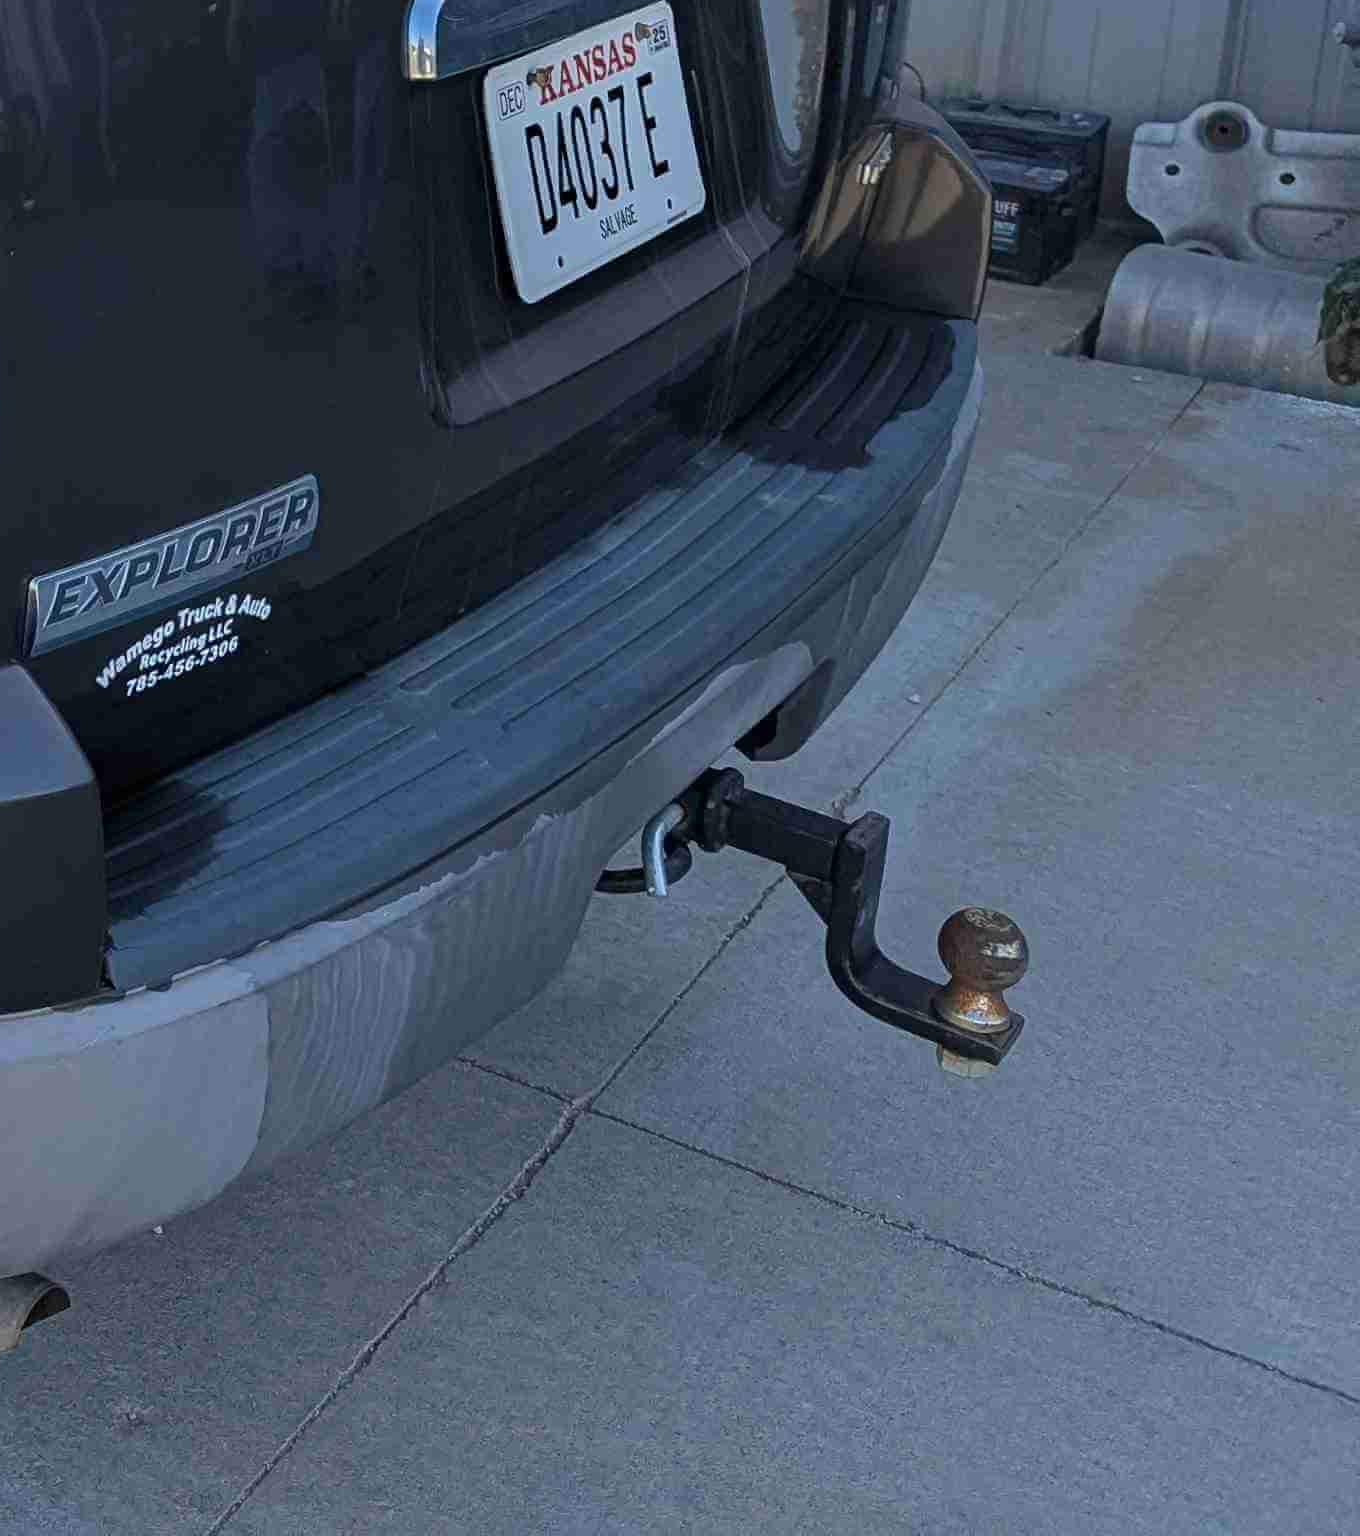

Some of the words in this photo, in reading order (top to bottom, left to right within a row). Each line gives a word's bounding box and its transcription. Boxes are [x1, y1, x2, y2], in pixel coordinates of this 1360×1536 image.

[652, 24, 667, 43] 25
[538, 31, 638, 105] KANSAS
[499, 85, 523, 117] DEC
[525, 84, 634, 235] D4037
[636, 71, 670, 178] E
[599, 203, 638, 240] SALVAGE
[42, 486, 315, 630] EXPLORER
[95, 619, 176, 689] Wamego
[177, 596, 222, 630] Truck
[224, 594, 238, 617] &
[238, 594, 273, 621] Auto
[138, 631, 206, 671] Recycling
[207, 618, 234, 643] LLC
